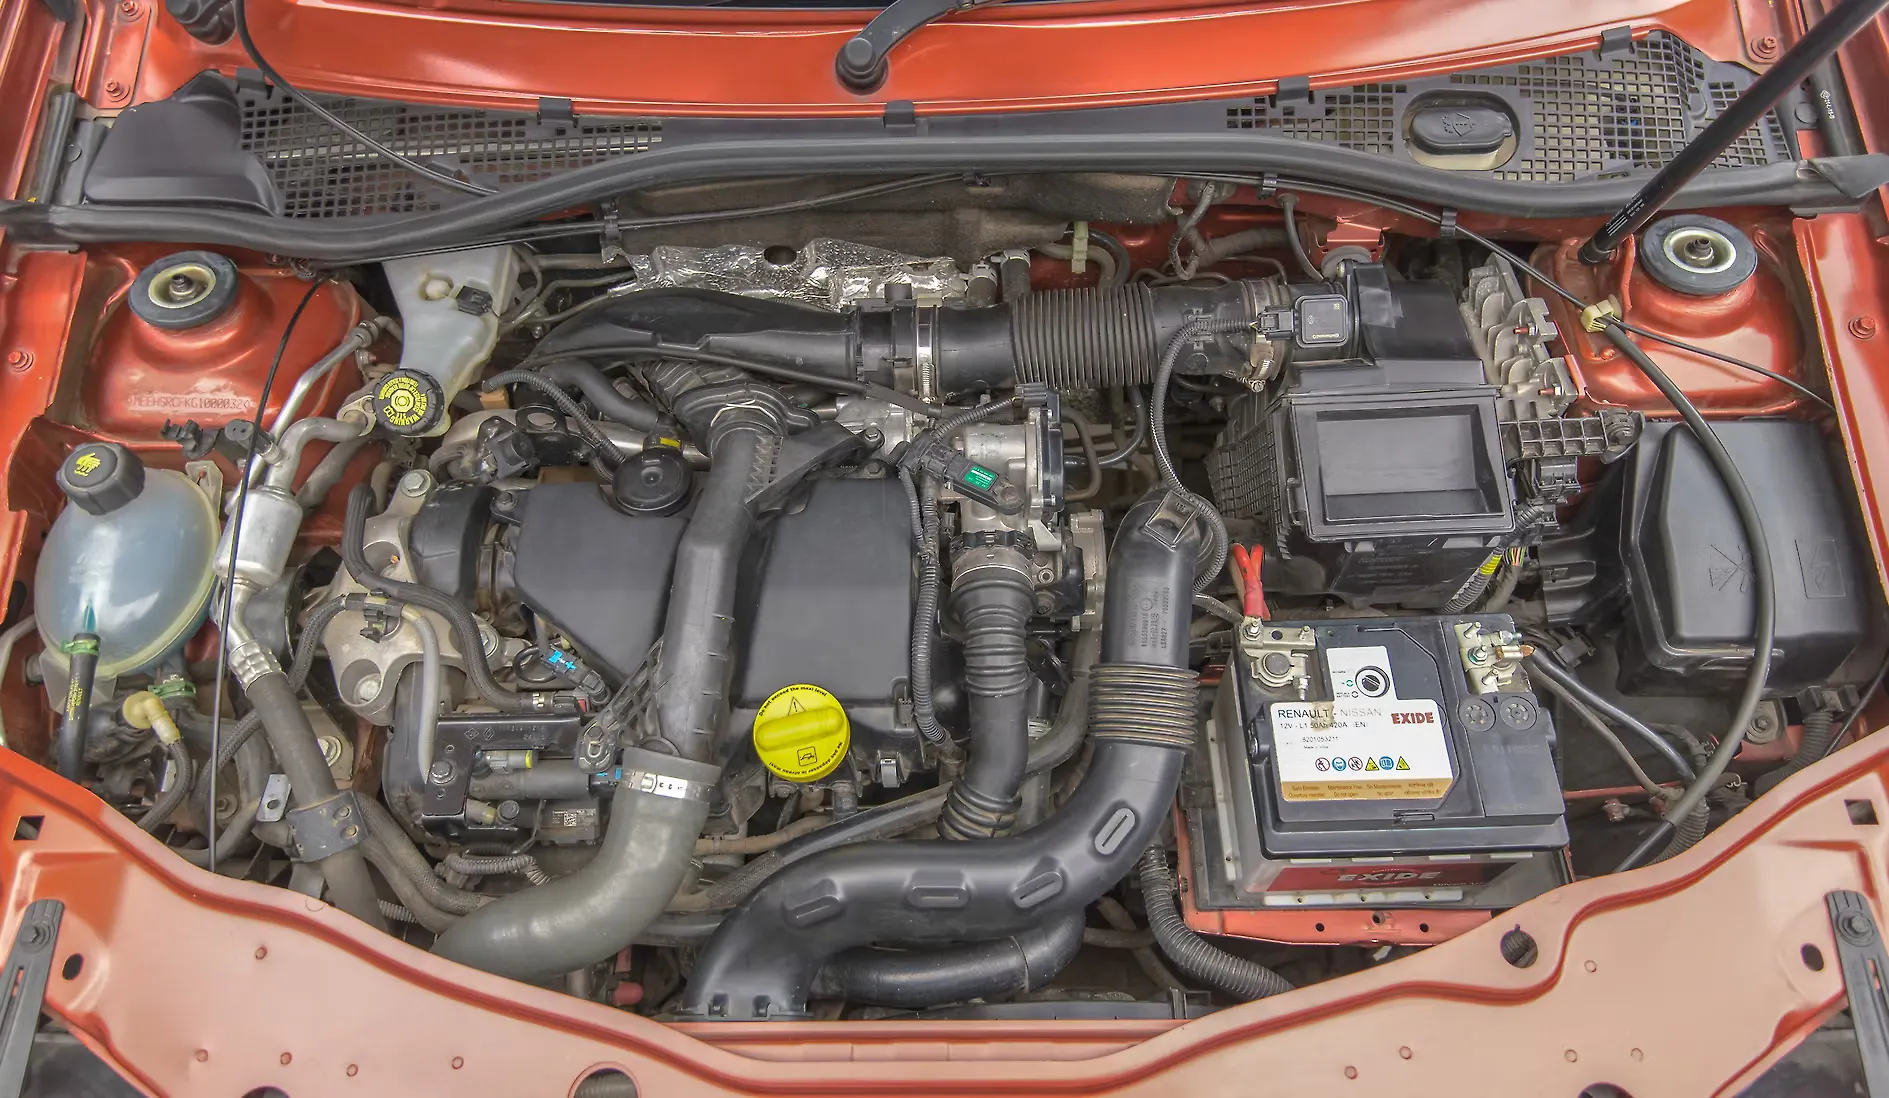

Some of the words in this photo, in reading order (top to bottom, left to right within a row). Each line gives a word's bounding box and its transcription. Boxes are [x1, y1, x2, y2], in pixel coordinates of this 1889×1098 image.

[772, 688, 789, 701] exceed
[1278, 709, 1329, 718] RENAULT
[1340, 708, 1382, 717] NISSAN
[1391, 712, 1434, 725] EXIDE
[1338, 871, 1440, 881] EXIDE
